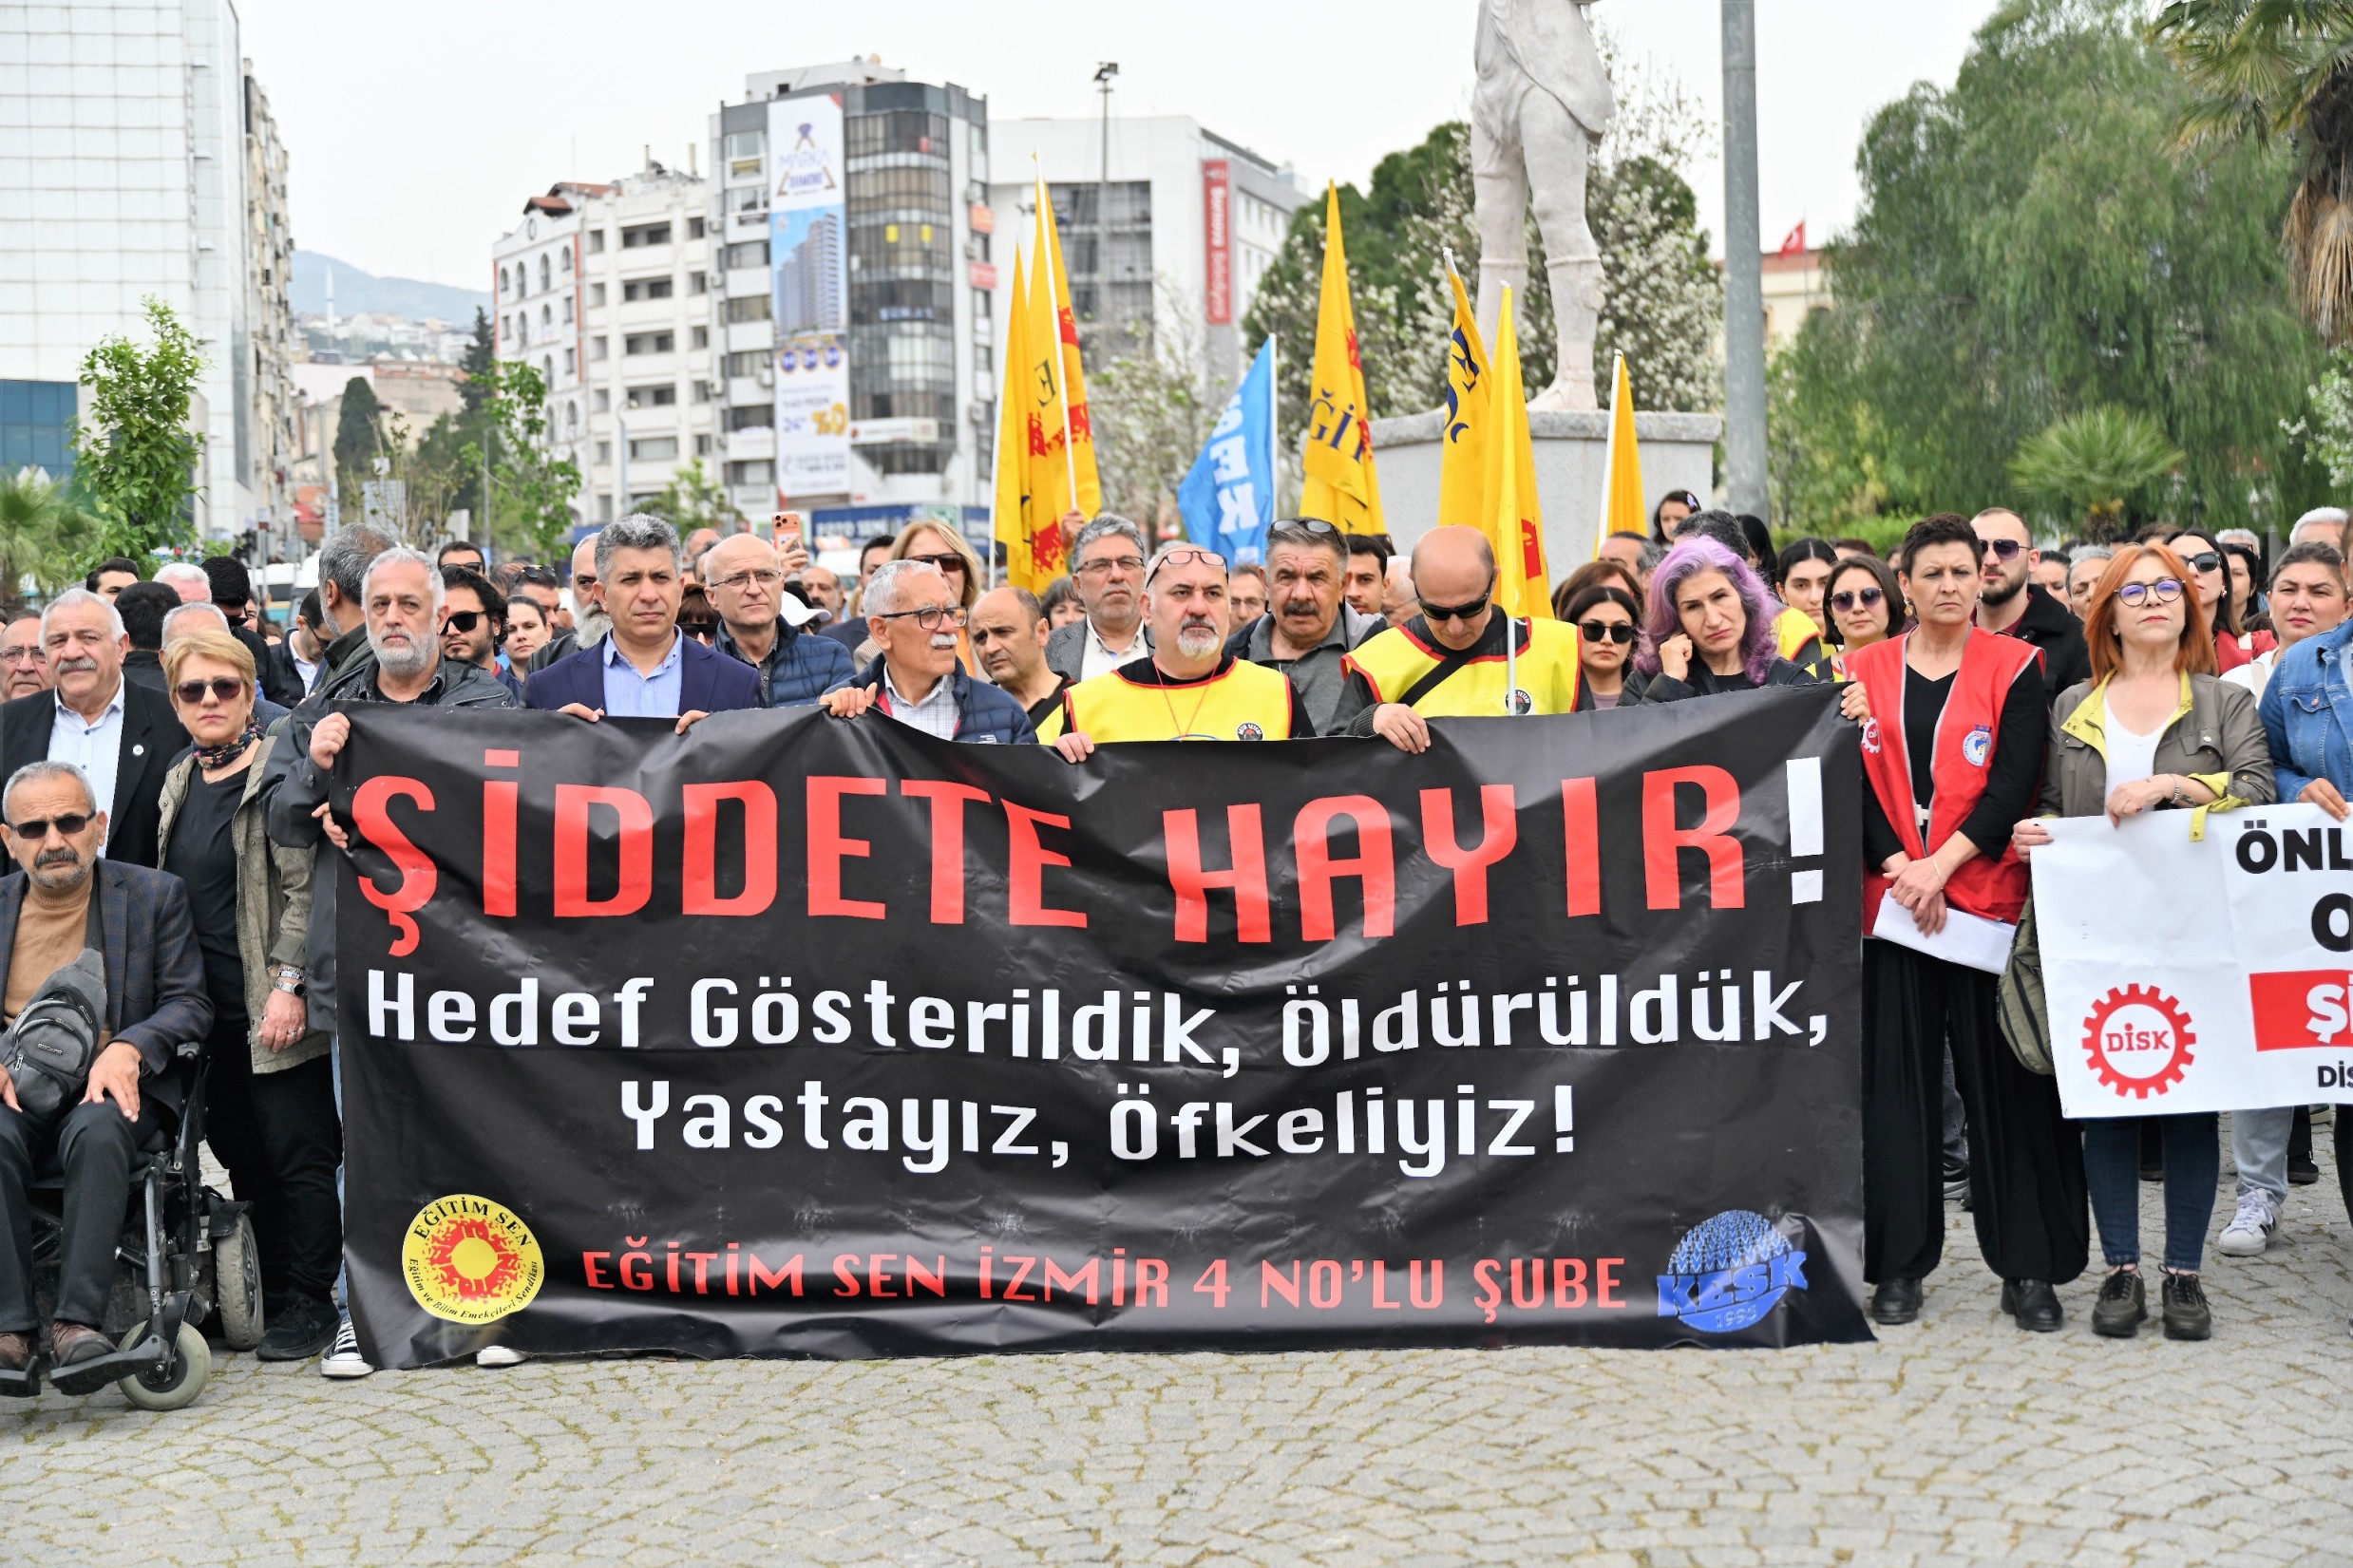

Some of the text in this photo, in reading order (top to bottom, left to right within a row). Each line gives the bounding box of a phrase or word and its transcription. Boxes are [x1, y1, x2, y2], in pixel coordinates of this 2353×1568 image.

[351, 749, 1088, 957] ŞİDDETE
[368, 967, 1827, 1080] Hedef Gösterildik, Öldürüldük,
[2106, 1022, 2171, 1052] DİSK
[621, 1080, 1574, 1178] Yastayız, Öfkeliyiz!
[413, 1197, 533, 1247] EĞİTİM SEN
[408, 1258, 539, 1319] Eğitim ve Bilim Emekçileri Sendikası
[581, 1236, 805, 1297] EĞİTİM
[833, 1254, 946, 1298] SEN
[978, 1245, 1169, 1308] İZMİR
[1193, 1258, 1231, 1308] 4
[1473, 1257, 1626, 1323] ŞUBE
[1657, 1251, 1809, 1317] KESK
